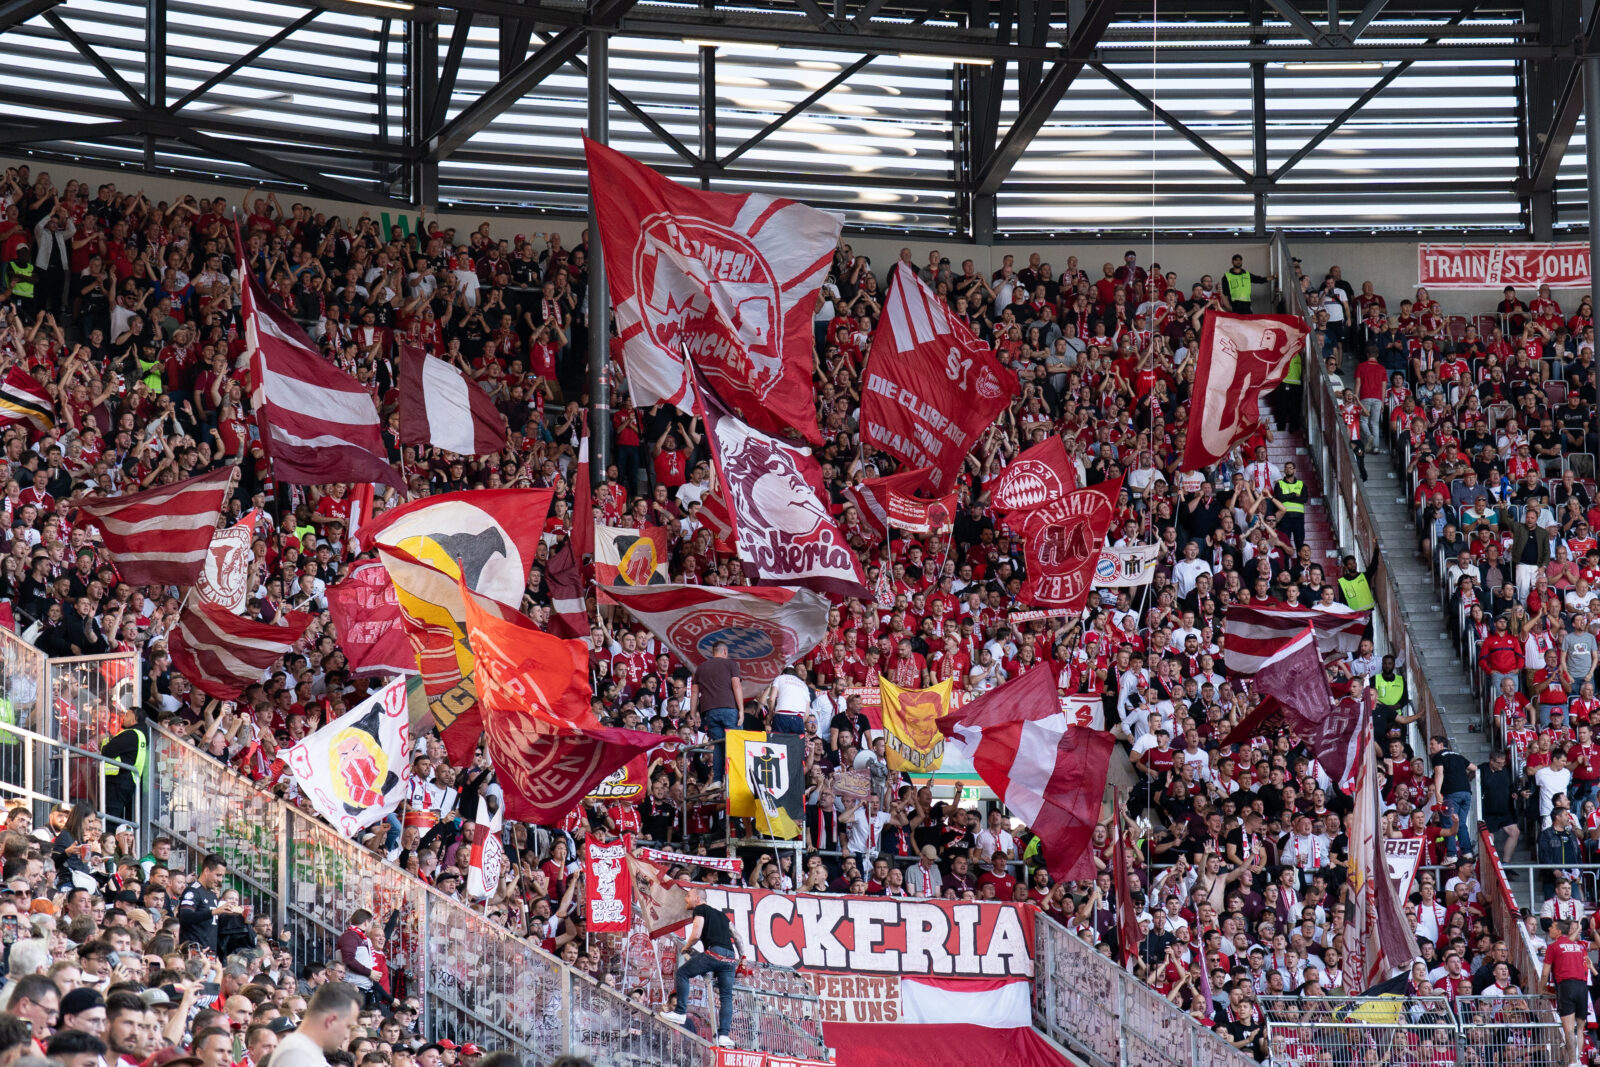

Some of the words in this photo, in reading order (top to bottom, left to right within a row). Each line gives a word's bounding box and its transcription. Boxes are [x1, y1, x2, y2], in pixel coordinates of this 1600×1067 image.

[1426, 255, 1485, 278] TRAIN
[1504, 256, 1532, 278] ST.
[1537, 254, 1591, 278] JOHA
[867, 373, 899, 400] DIE
[898, 388, 967, 448] CLUBFA
[1385, 841, 1421, 856] RAS
[818, 1000, 848, 1022] BEI
[853, 1000, 898, 1023] UNS
